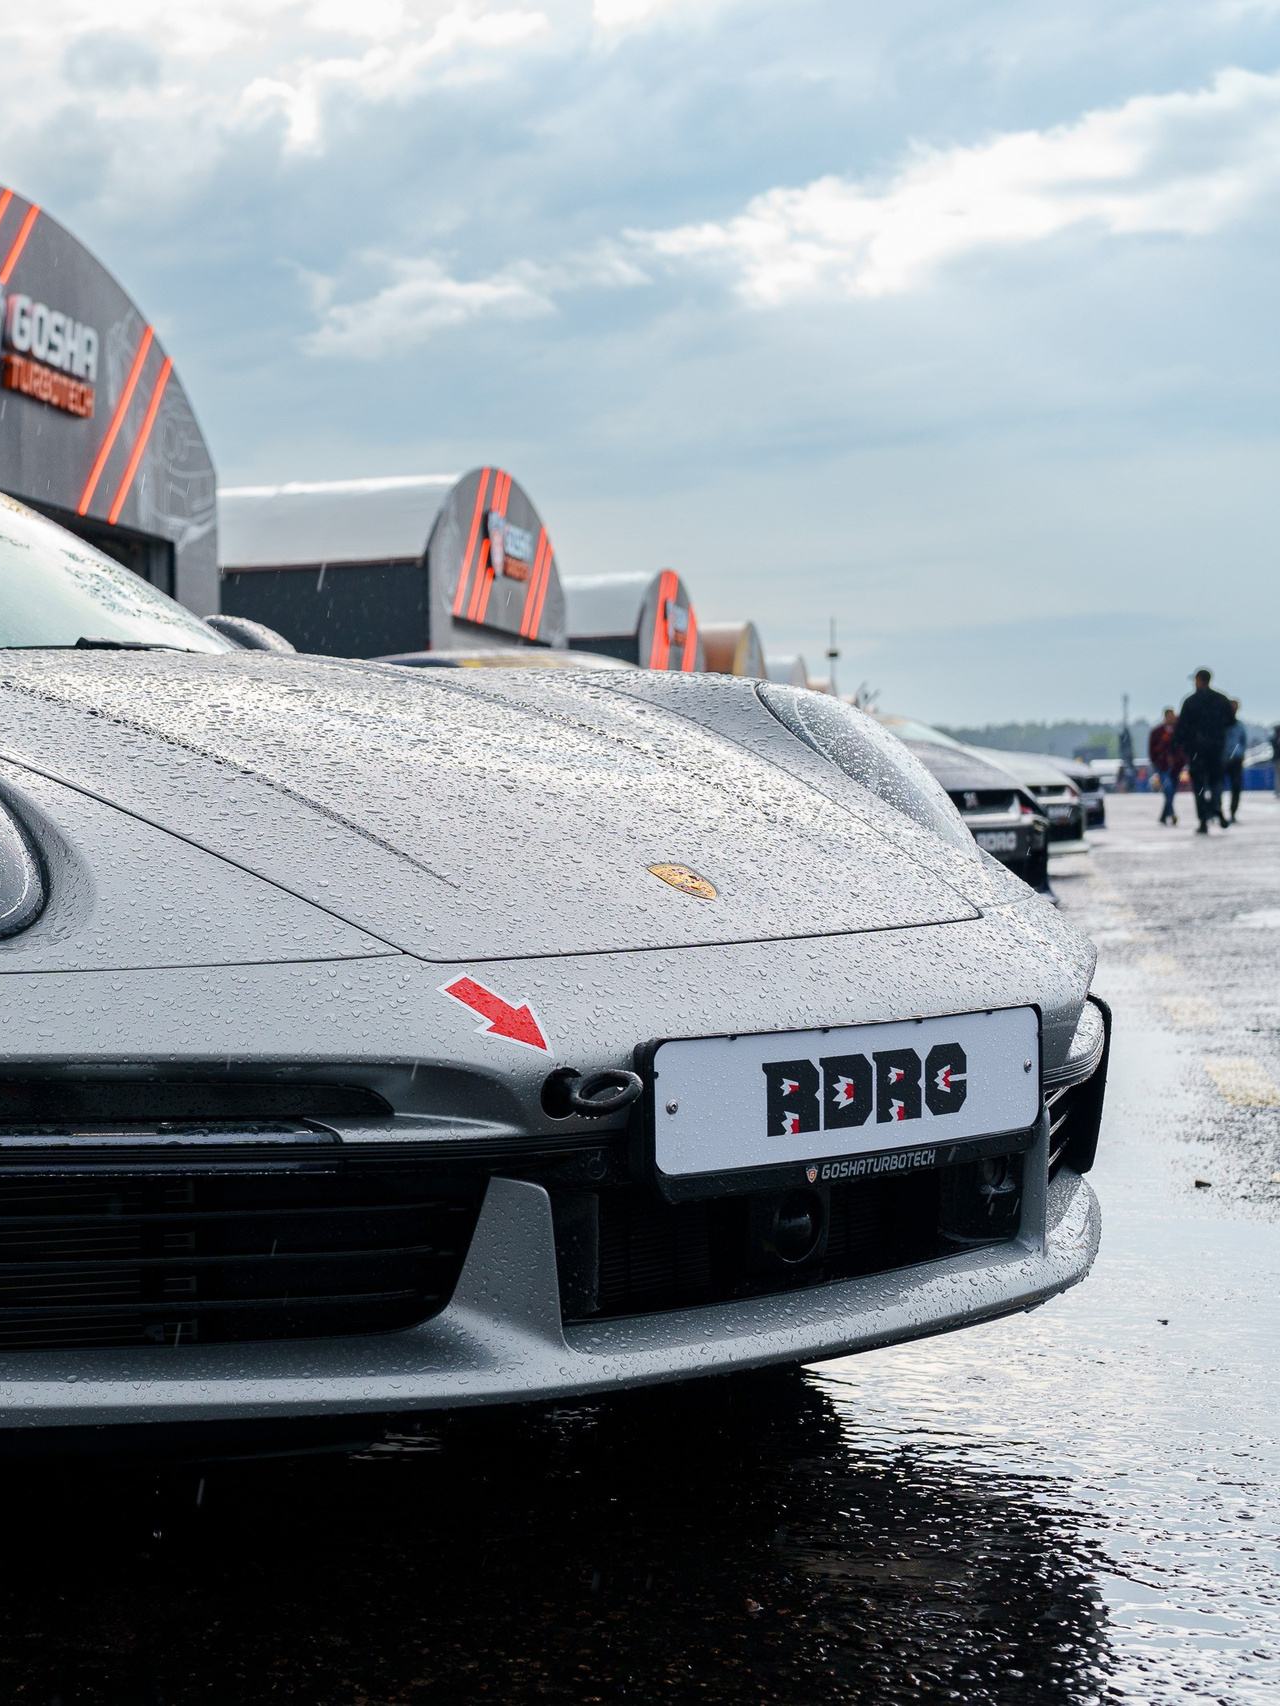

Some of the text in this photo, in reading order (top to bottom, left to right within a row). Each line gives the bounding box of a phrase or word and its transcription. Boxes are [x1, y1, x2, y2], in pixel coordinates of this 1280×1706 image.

[10, 294, 99, 381] GOSHA
[5, 354, 94, 418] TURBOTECH
[762, 1042, 967, 1137] RDRC
[821, 1149, 936, 1180] GOSHATURBOTECH
